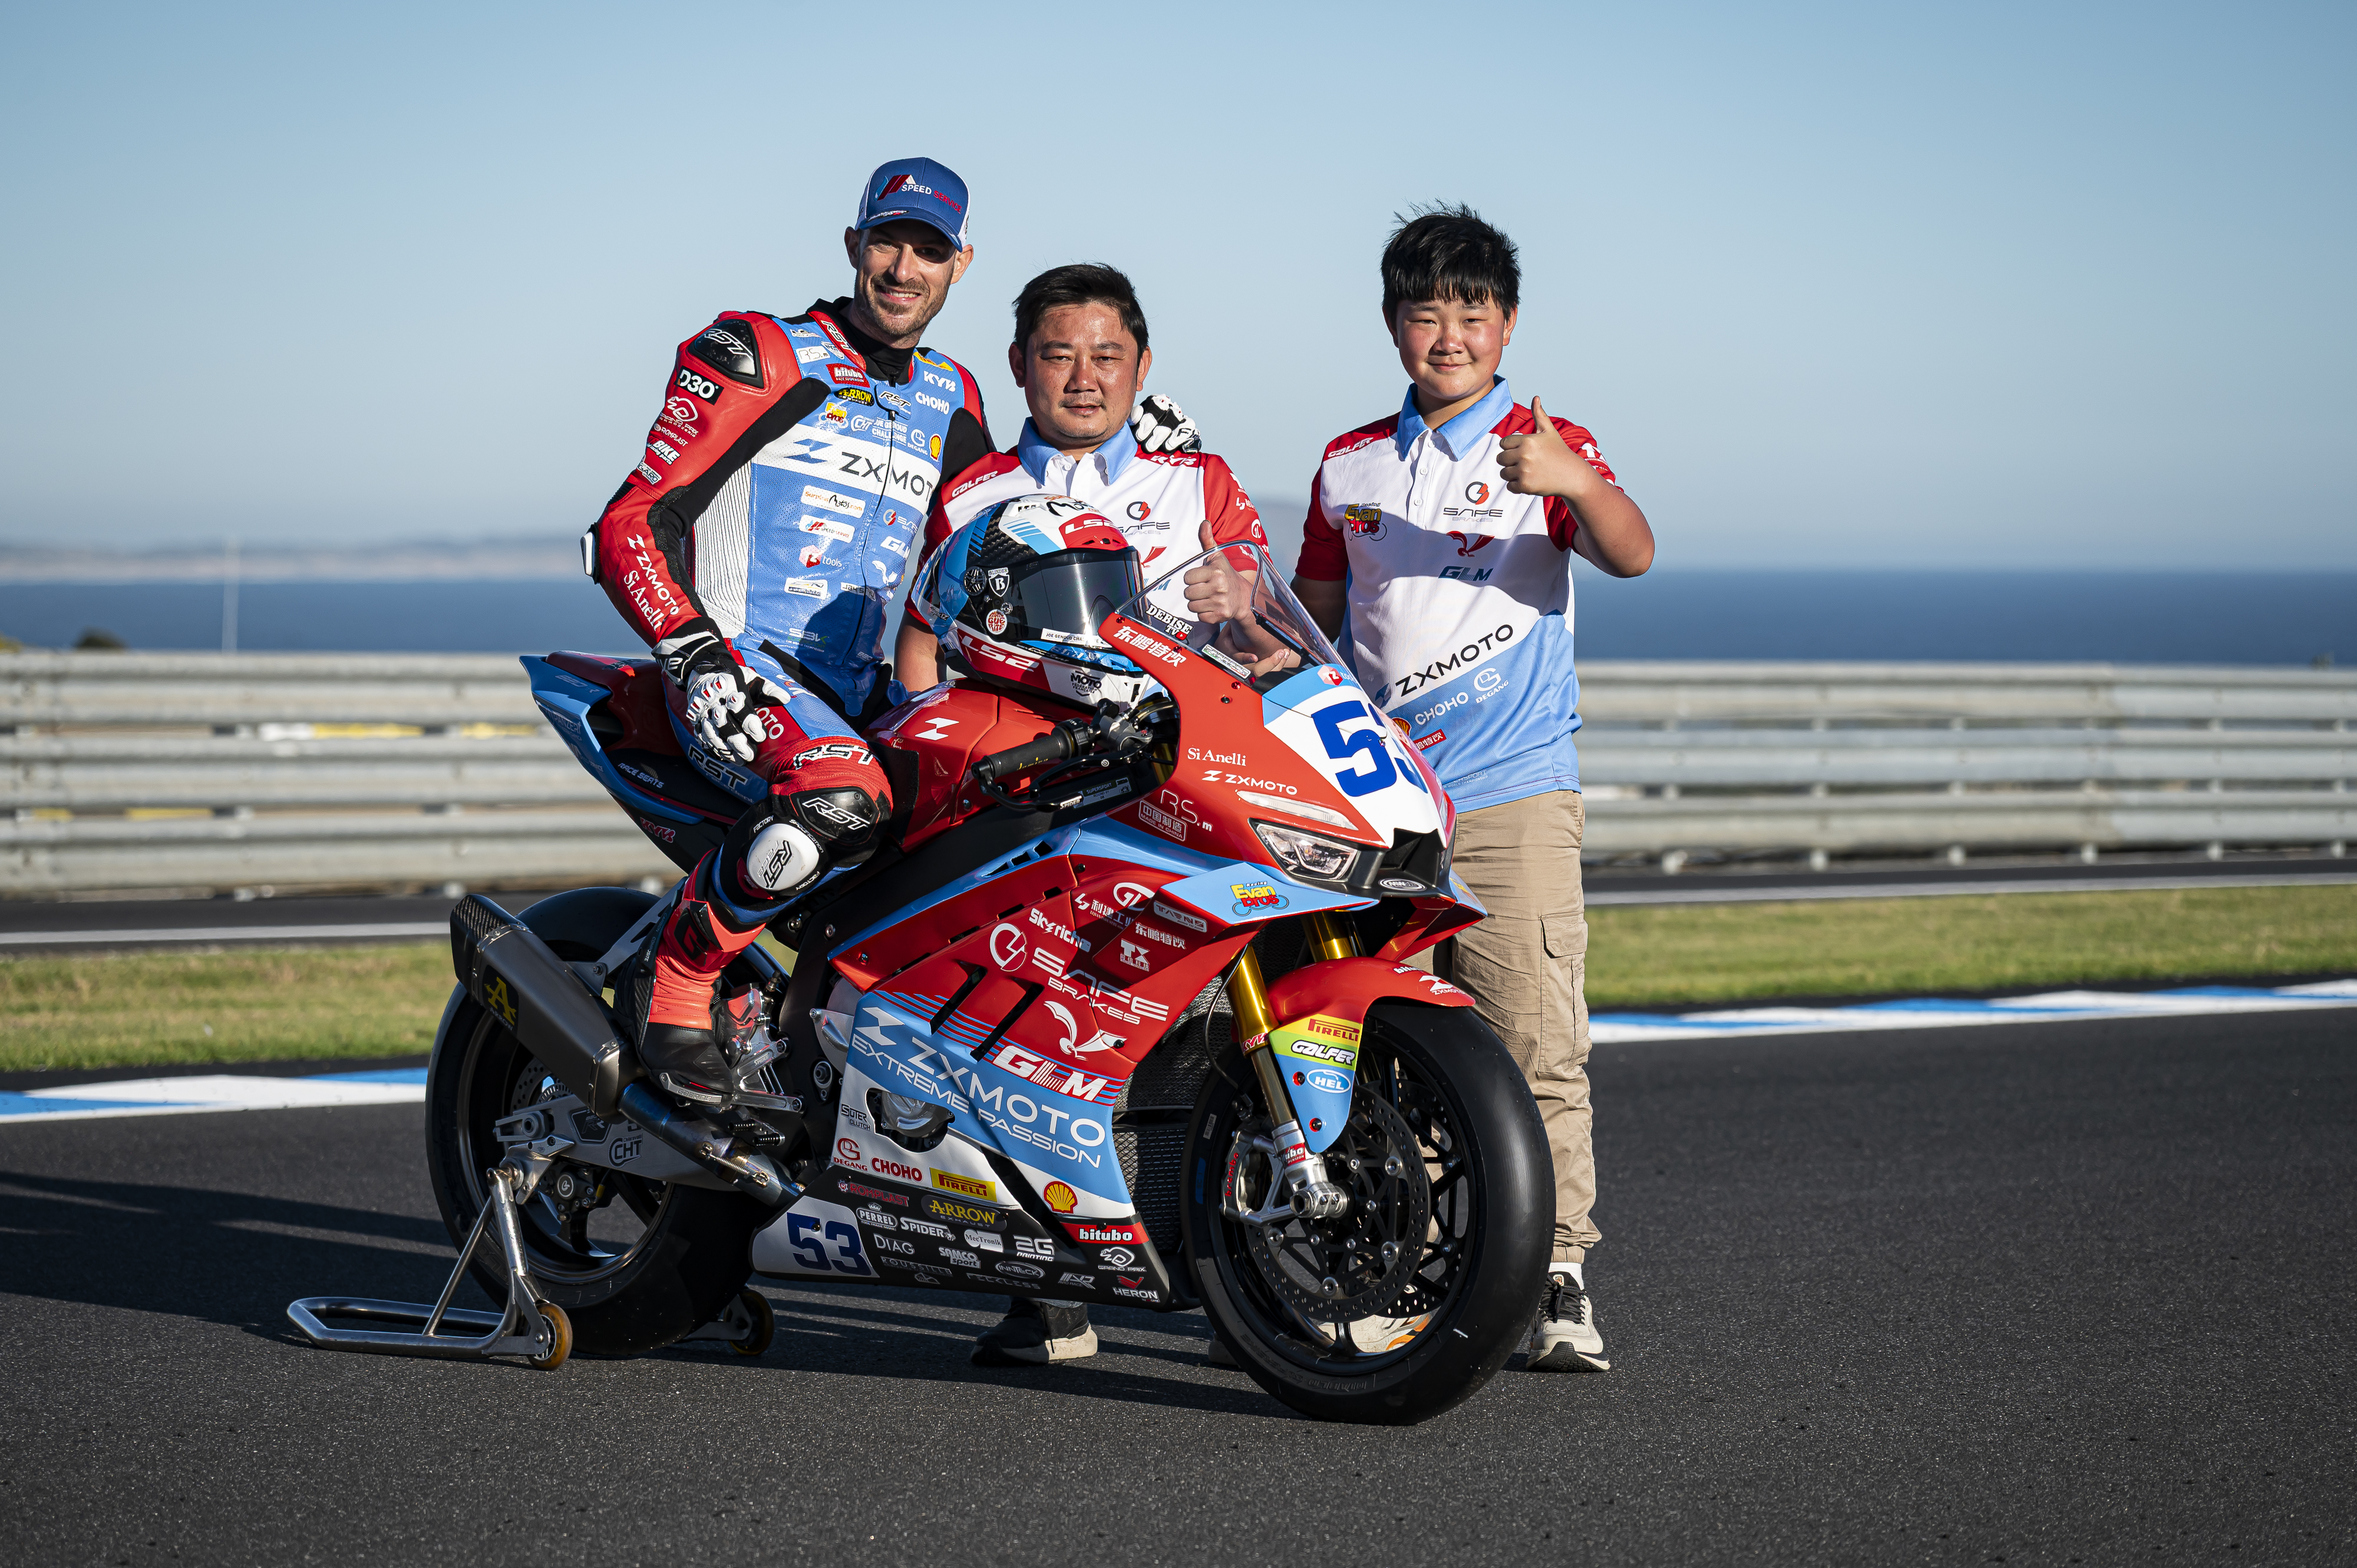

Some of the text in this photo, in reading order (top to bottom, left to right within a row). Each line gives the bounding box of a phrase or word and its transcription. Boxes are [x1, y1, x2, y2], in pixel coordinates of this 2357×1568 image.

[902, 184, 962, 214] SPEED SERVICE
[820, 320, 859, 355] RST
[834, 367, 863, 378] bitubo
[923, 371, 956, 392] KYB
[838, 389, 872, 404] ARROW
[879, 391, 911, 407] RST
[915, 392, 949, 415] CHOHO
[661, 427, 688, 447] ROMPLAST
[685, 424, 698, 435] PRIX
[653, 440, 681, 461] BIKE
[907, 443, 928, 455] DEGANG
[1328, 437, 1374, 458] GALFER
[659, 454, 672, 465] parts
[839, 451, 933, 502] ZXMOT
[952, 470, 998, 498] GALFER
[1345, 504, 1382, 521] Evan
[1443, 507, 1504, 518] SAFE
[1349, 519, 1380, 534] Bros
[823, 556, 842, 567] tools
[636, 550, 679, 615] ZXMOTO
[995, 577, 1005, 590] B
[1438, 566, 1494, 582] GLM
[631, 587, 665, 631] Anelli
[1146, 605, 1193, 635] DEBISE
[1166, 625, 1180, 636] TV
[961, 635, 1041, 672] LS2
[1113, 625, 1187, 668] 东鹏特饮
[1395, 624, 1514, 697] ZXMOTO
[1071, 673, 1102, 689] MOTO
[1475, 679, 1509, 704] DEGANG
[1415, 692, 1469, 726] CHOHO
[688, 743, 748, 790] RST
[1187, 747, 1246, 767] Si Anelli
[618, 762, 665, 788] RACE SEATS
[1225, 774, 1298, 795] ZXMOTO
[1087, 783, 1112, 794] SUPERSPORT
[1060, 795, 1082, 810] SPIDER
[802, 797, 870, 830] RST
[1143, 804, 1182, 833] 中国制造
[640, 817, 676, 843] KYB
[1140, 813, 1157, 826] MADE
[1165, 826, 1183, 840] CHINA
[1230, 884, 1276, 900] Evan
[1241, 894, 1279, 907] Bros
[656, 913, 668, 932] CARBON
[1135, 922, 1186, 950] 东鹏特饮
[1032, 947, 1169, 1022] SAFE
[1048, 976, 1141, 1025] BRAKES
[490, 1006, 514, 1031] ARROW
[1308, 1019, 1360, 1042] PIRELLI
[754, 1052, 769, 1067] SPIDER
[1292, 1041, 1356, 1065] GALFER
[851, 1034, 969, 1114] EXTREME
[992, 1045, 1108, 1101] GLM
[1315, 1077, 1344, 1090] HEL
[907, 1036, 1105, 1147] ZXMOTO
[849, 1118, 871, 1131] CLUTCH
[978, 1108, 1101, 1168] PASSION
[613, 1138, 643, 1161] CHT
[833, 1156, 868, 1171] DEGANG
[871, 1157, 923, 1182] CHOHO
[938, 1173, 988, 1197] PIRELLI
[1224, 1152, 1239, 1197] brembo
[850, 1183, 909, 1207] ROMPLAST
[860, 1210, 893, 1226] PERREL
[929, 1200, 996, 1224] ARROW
[940, 1215, 990, 1228] EXHAUST
[900, 1217, 948, 1237] SPIDER
[1079, 1229, 1133, 1241] bitubo
[786, 1212, 872, 1276] 53
[873, 1233, 915, 1255] DIAG
[965, 1232, 1002, 1246] MecTronik
[939, 1246, 978, 1260] SAMCO
[952, 1257, 977, 1267] sport
[1016, 1252, 1054, 1262] PAINTING
[881, 1256, 952, 1275] ROUSSILLE
[1113, 1287, 1159, 1300] HERON
